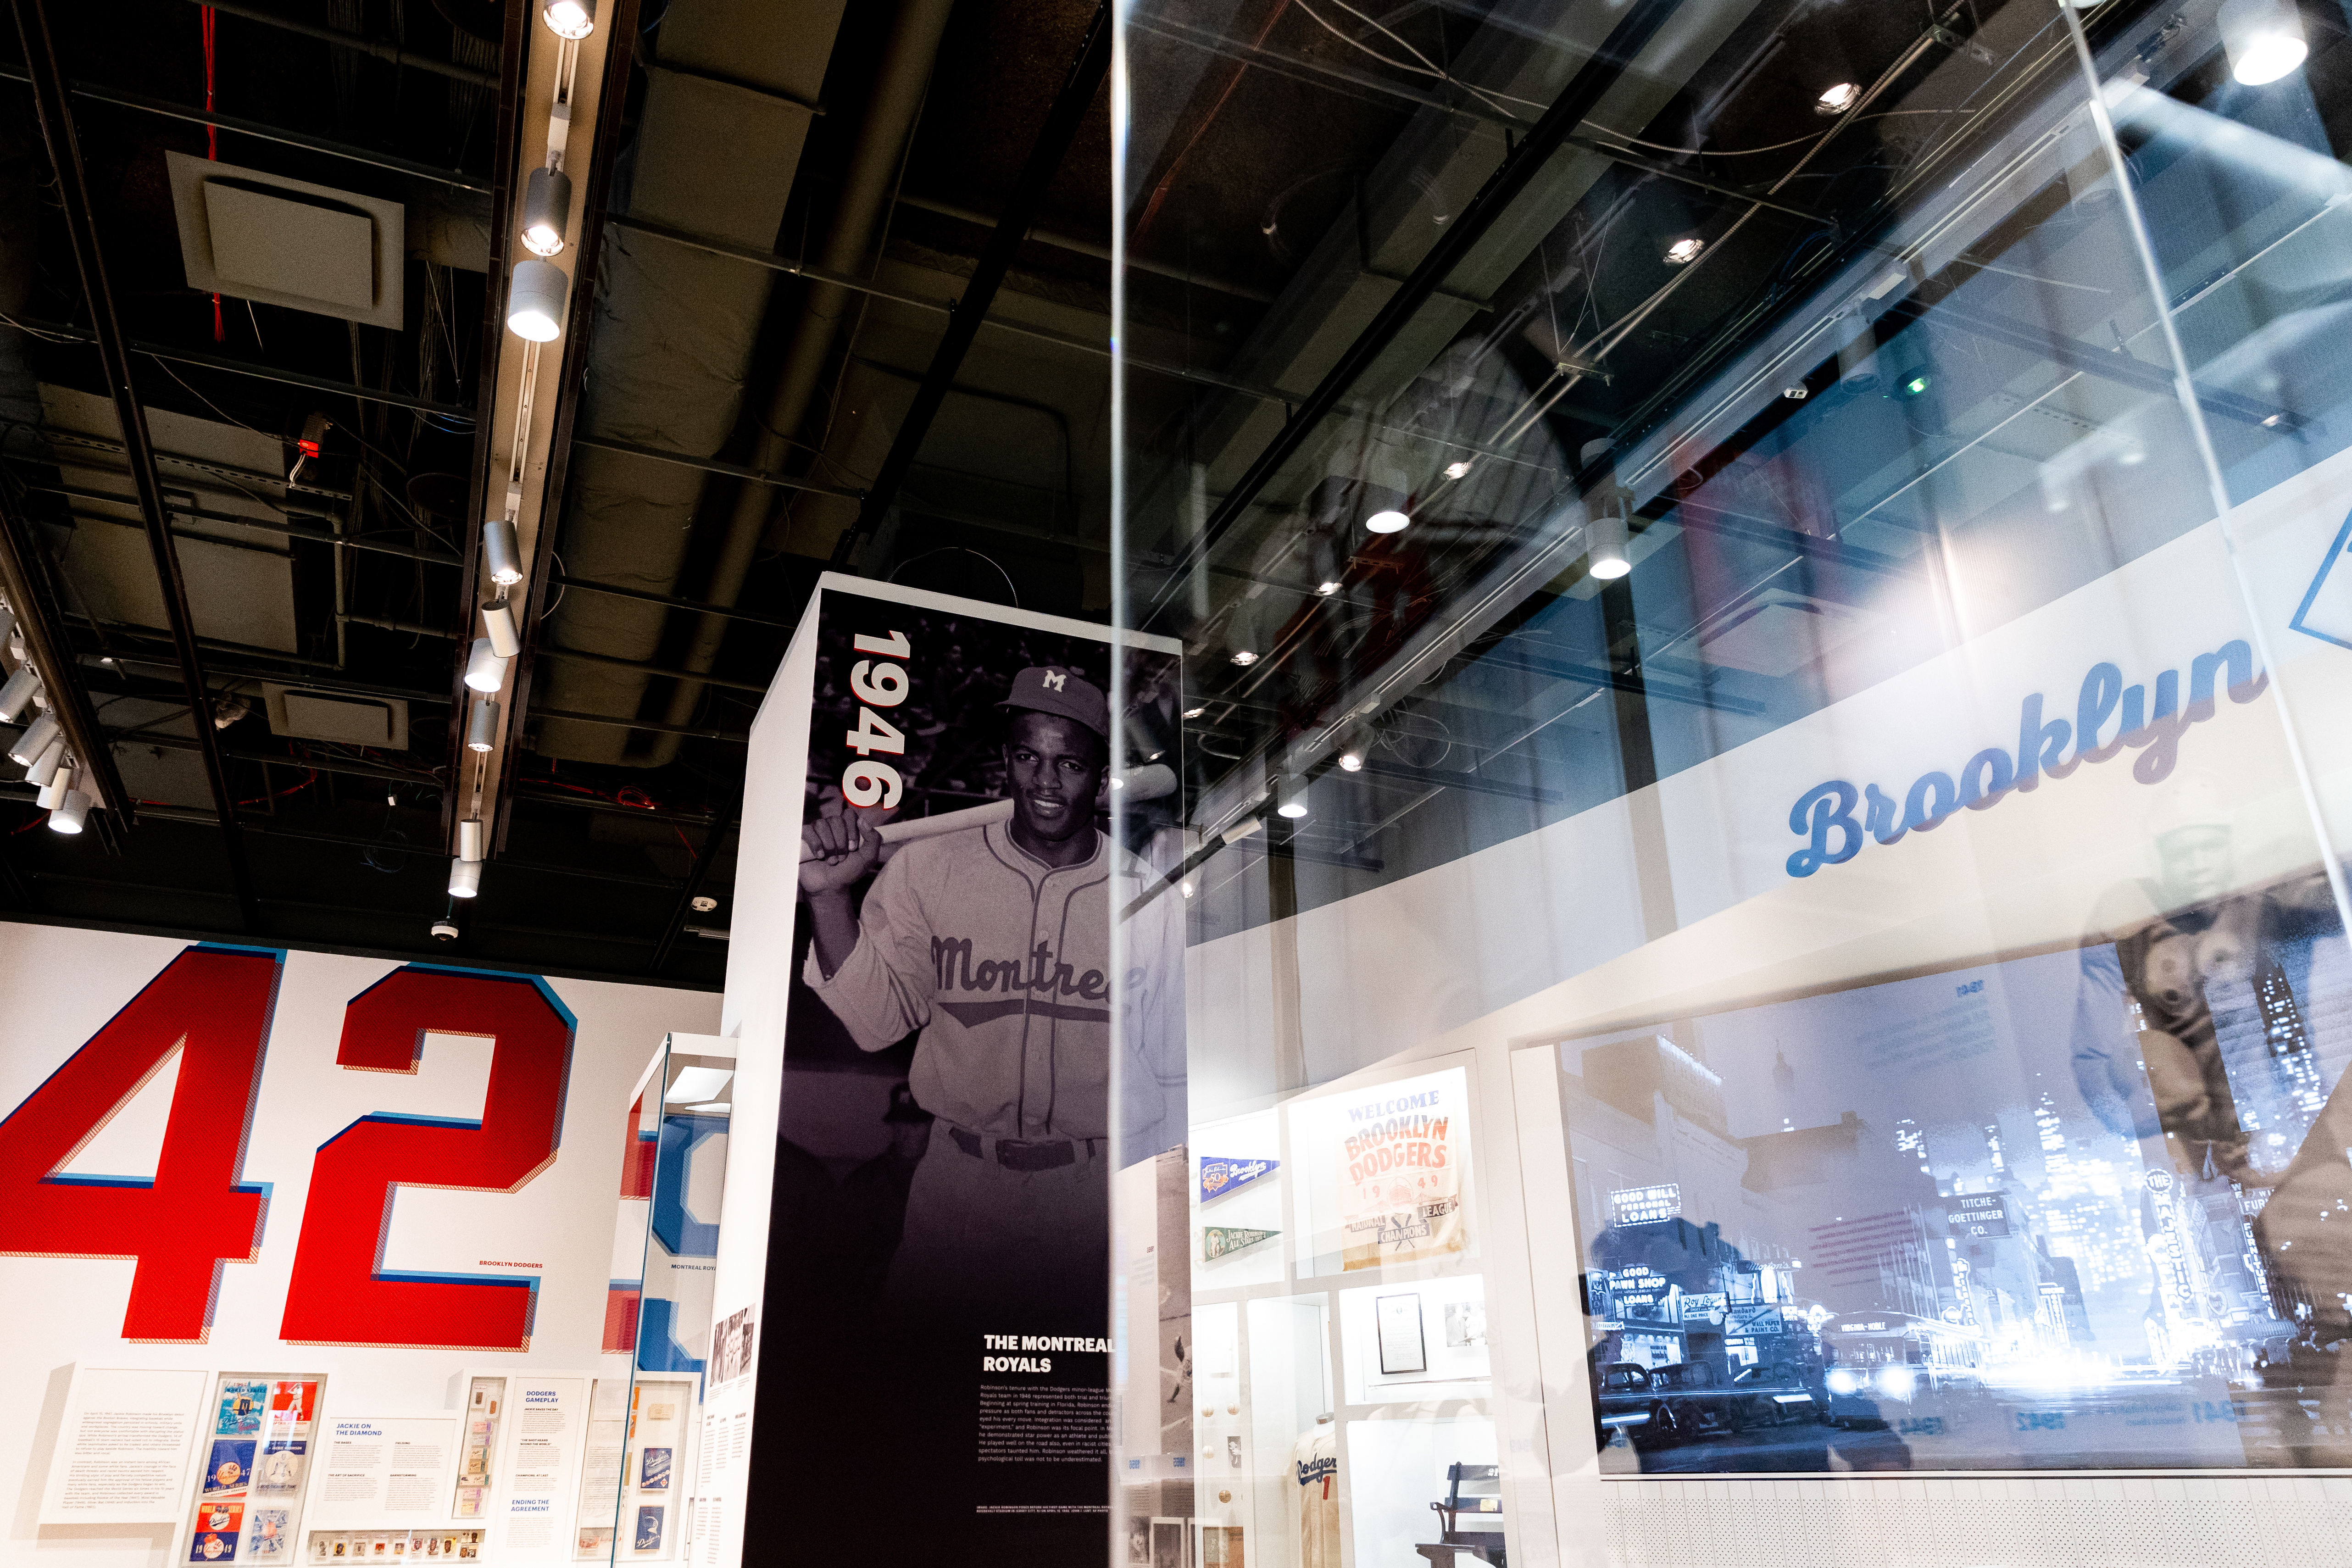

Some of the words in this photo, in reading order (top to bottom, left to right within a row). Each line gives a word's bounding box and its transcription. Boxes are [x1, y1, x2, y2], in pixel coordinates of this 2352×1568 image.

[1042, 670, 1067, 693] M
[842, 630, 912, 811] 1946
[1786, 639, 2270, 879] Brooklyn
[1348, 1090, 1439, 1123] WELCOME
[1344, 1115, 1448, 1162] BROOKLYN
[0, 941, 577, 1352] 42
[1230, 1160, 1266, 1178] Brooklyn
[1349, 1142, 1446, 1186] DODGERS
[1210, 1173, 1221, 1183] 50
[2148, 1174, 2170, 1188] THE
[1613, 1191, 1643, 1204] GOOD
[1423, 1202, 1453, 1218] LEAGUE
[1622, 1208, 1667, 1223] LOANS
[1948, 1210, 2003, 1223] GOETTINGER
[1226, 1229, 1244, 1242] JACKIE
[1970, 1226, 1988, 1234] CO.
[1229, 1241, 1240, 1251] ALL
[2154, 1193, 2192, 1297] MAJESTIC
[2243, 1223, 2269, 1294] FURNITURE
[1748, 1261, 1790, 1270] Morton's
[1623, 1267, 1649, 1278] GOOD
[1609, 1279, 1635, 1290] PAWN
[1638, 1277, 1666, 1289] SHOP
[1624, 1294, 1654, 1304] LOANS
[1684, 1296, 1699, 1307] Roy
[984, 1334, 1018, 1350] THE
[1022, 1336, 1117, 1353] MONTREAL
[984, 1357, 1051, 1372] ROYALS
[646, 1453, 669, 1465] Dodgers
[206, 1474, 217, 1483] 19
[241, 1468, 250, 1476] 47
[1323, 1476, 1330, 1500] 1
[201, 1505, 216, 1513] WORLD
[228, 1505, 242, 1513] SERIES
[637, 1535, 660, 1547] Dodgers
[195, 1545, 203, 1554] 19
